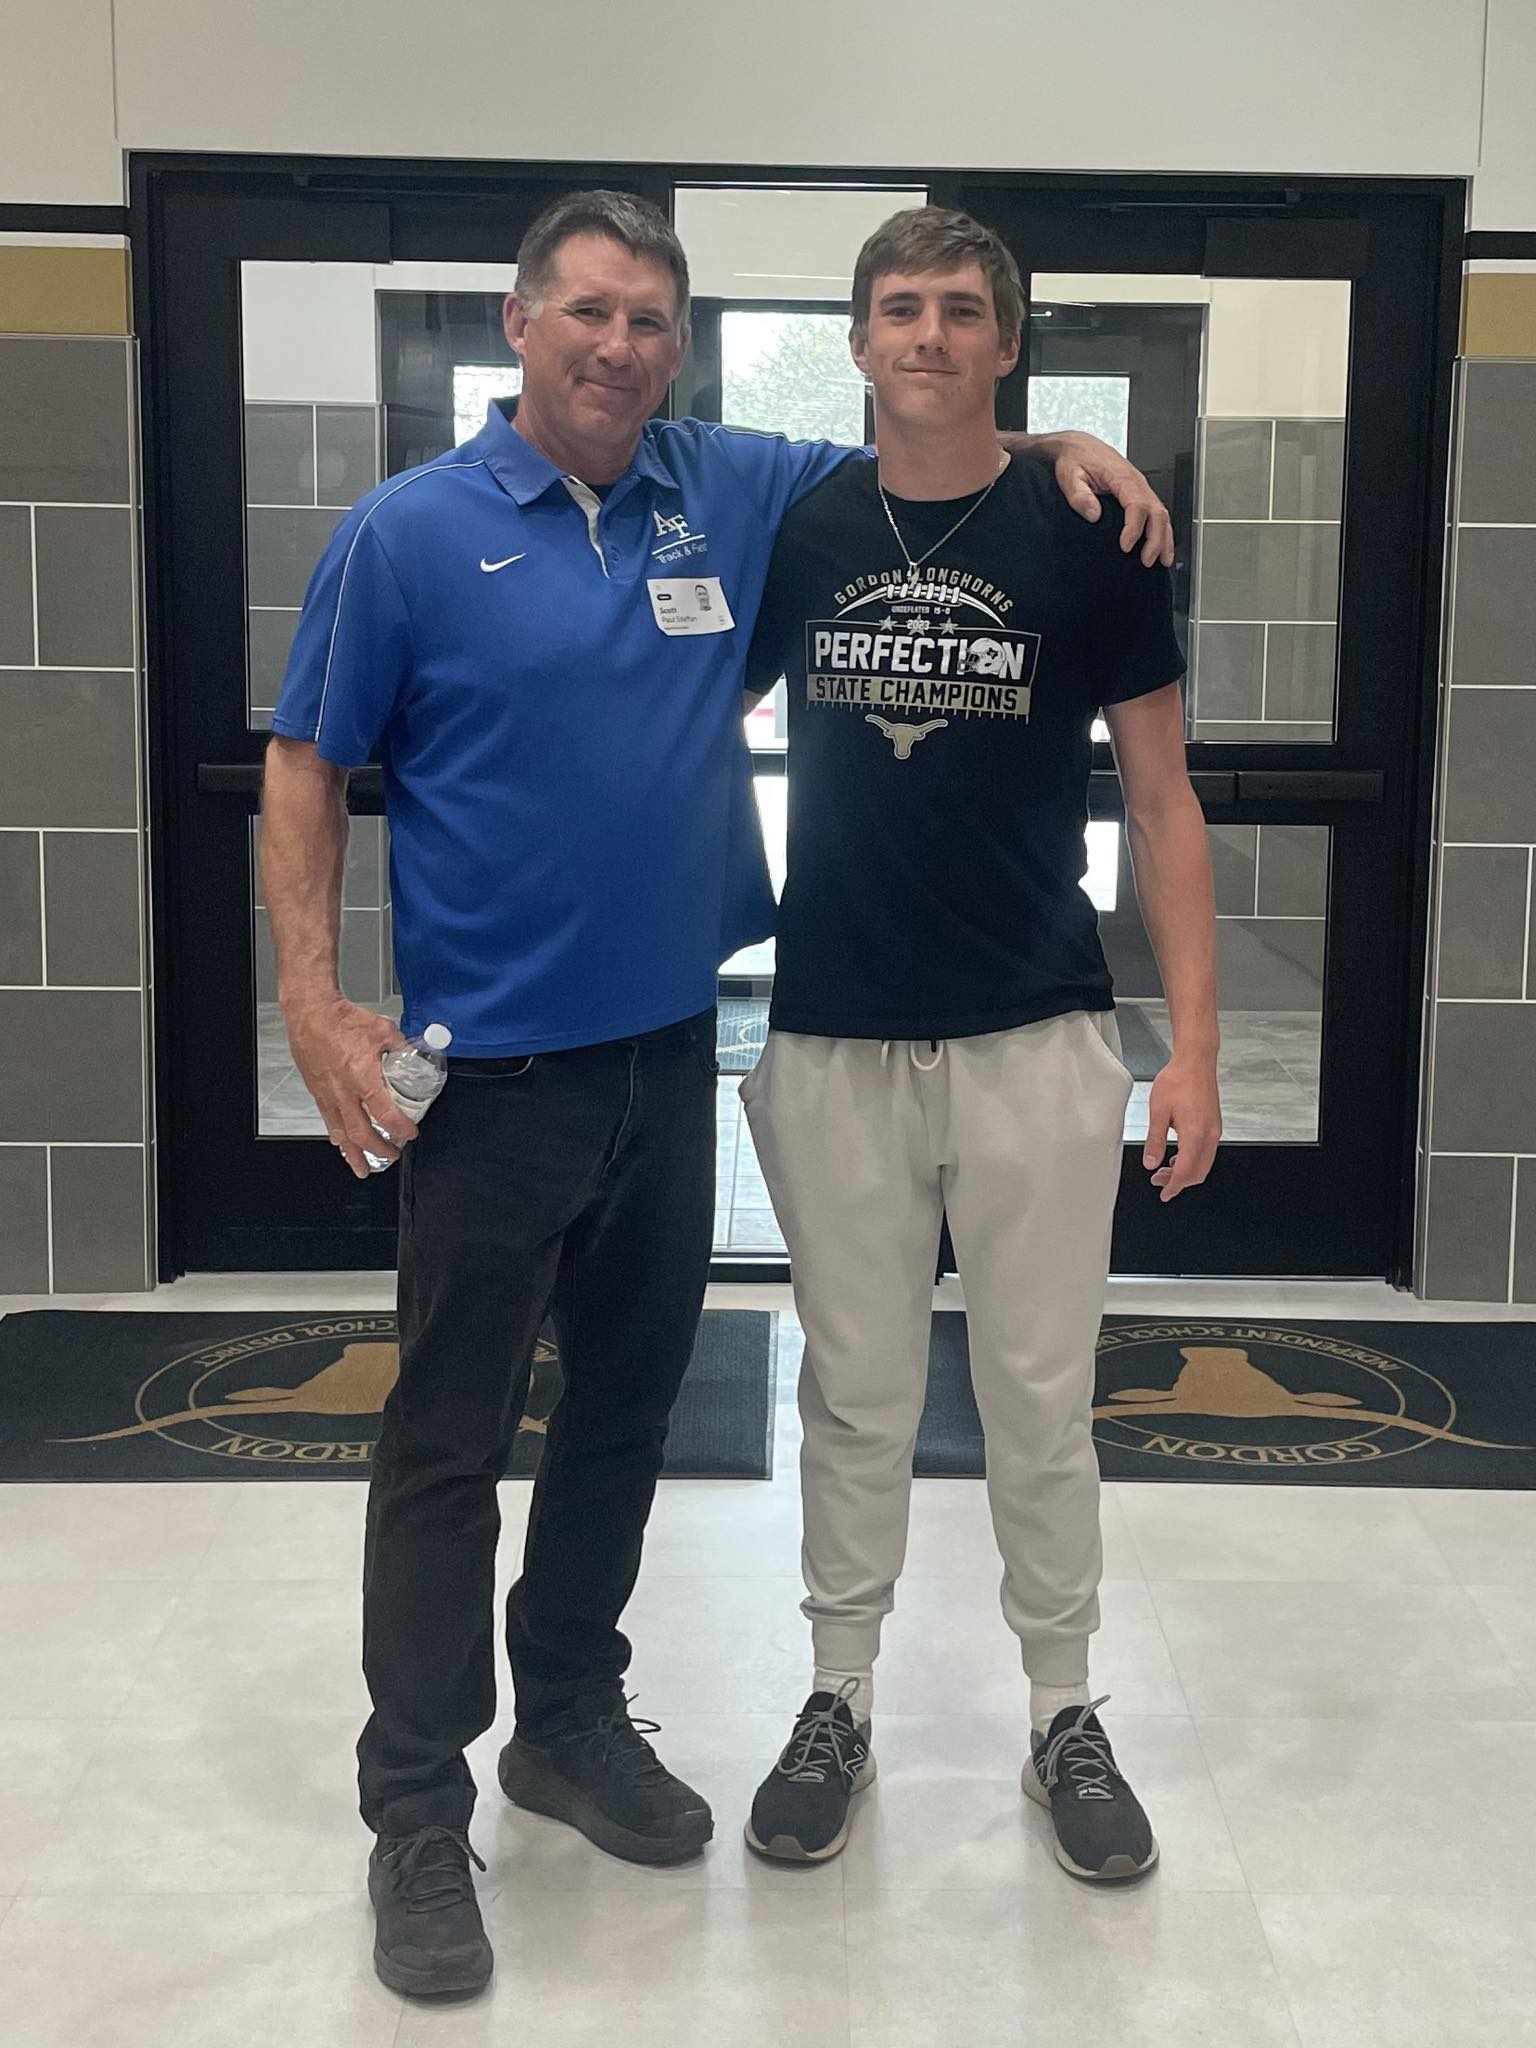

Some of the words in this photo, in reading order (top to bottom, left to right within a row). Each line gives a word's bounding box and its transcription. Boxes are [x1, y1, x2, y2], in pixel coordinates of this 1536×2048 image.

[653, 510, 690, 539] AF
[656, 548, 684, 564] Track
[683, 545, 692, 556] &
[833, 569, 902, 605] GORDON
[906, 619, 930, 631] 2023
[816, 676, 872, 701] STATE
[880, 680, 1018, 711] CHAMPIONS
[296, 1319, 396, 1337] CHOOL
[1118, 1326, 1225, 1339] SCHOOL
[193, 1332, 296, 1368] DISTRICT
[1231, 1328, 1401, 1372] INDEPENDENT
[209, 1436, 368, 1460] RDON
[1142, 1436, 1382, 1464] GORDON
